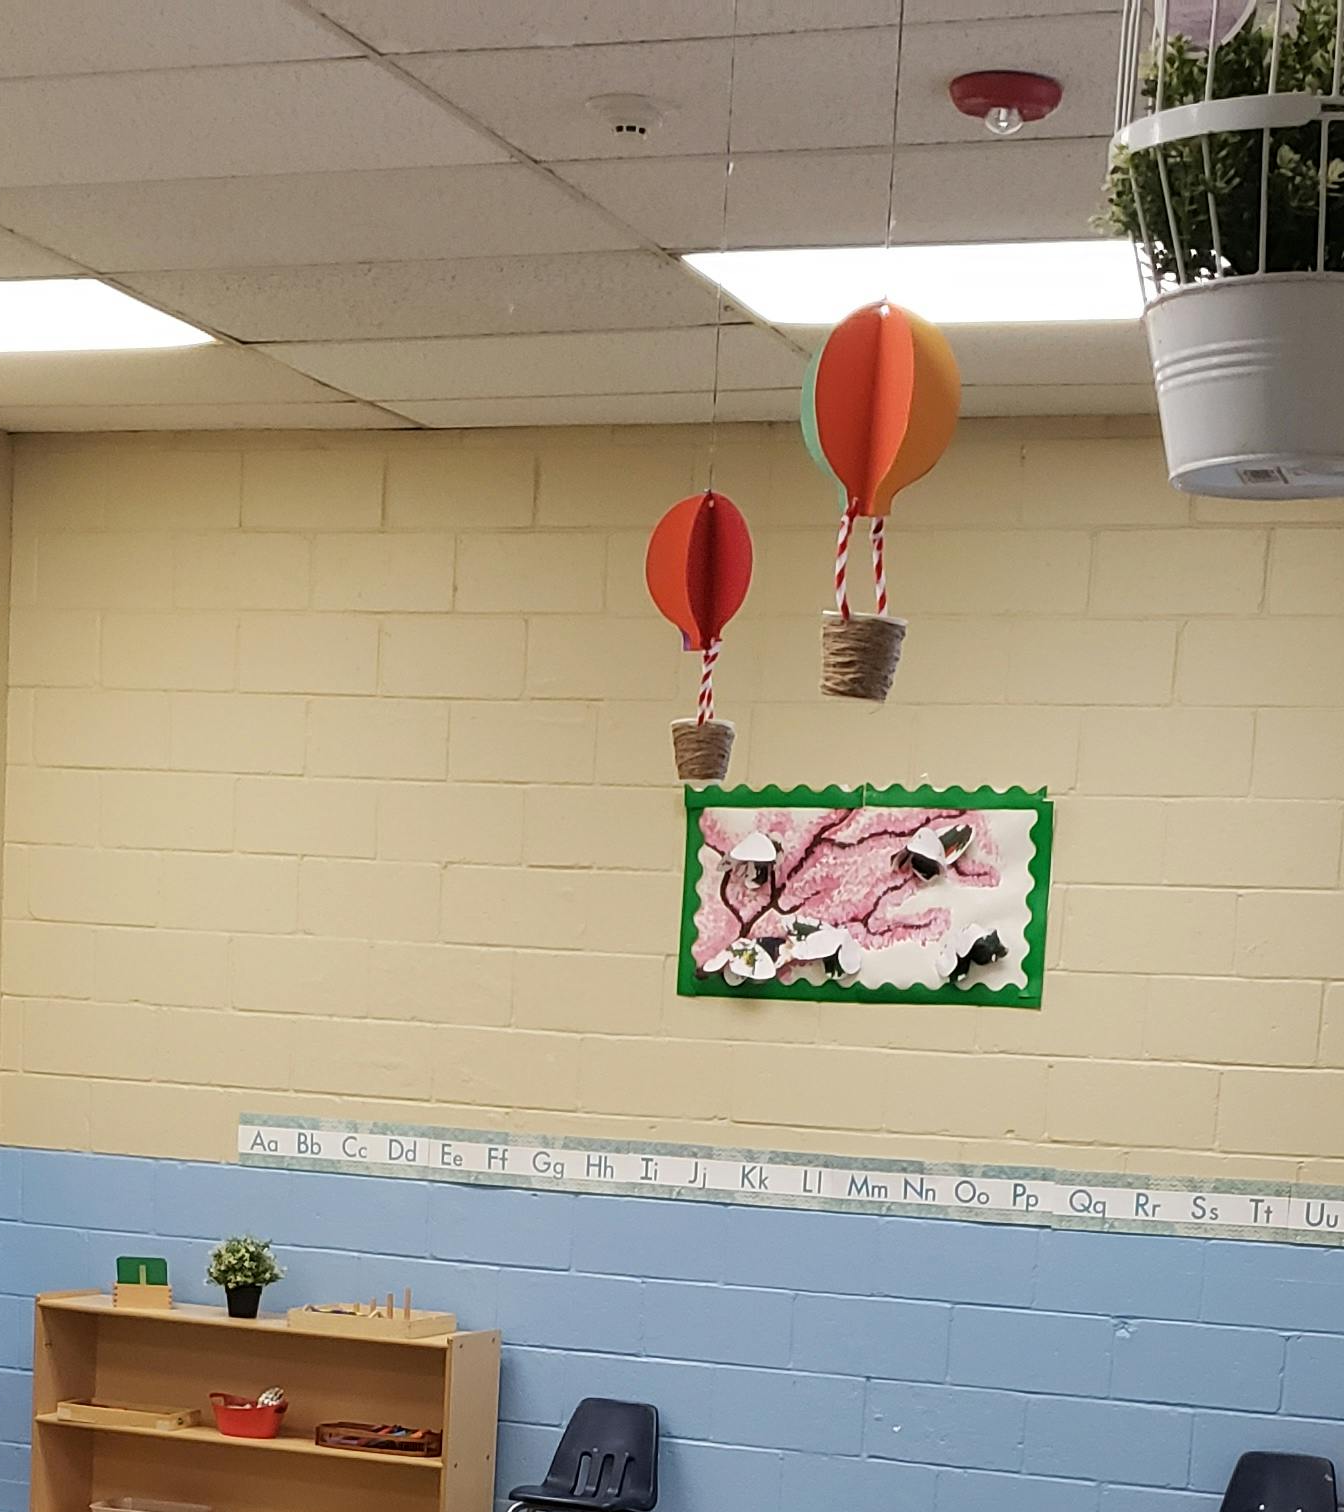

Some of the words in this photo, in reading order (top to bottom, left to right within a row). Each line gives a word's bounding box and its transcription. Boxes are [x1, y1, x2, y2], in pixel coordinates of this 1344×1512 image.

[250, 1131, 278, 1153] Aa
[297, 1133, 322, 1156] Bb
[342, 1136, 368, 1159] Cc
[388, 1139, 417, 1163] Dd
[441, 1144, 463, 1167] Ee
[487, 1148, 509, 1171] Ff
[532, 1151, 565, 1179] Gg
[585, 1155, 614, 1180] Hh
[640, 1157, 658, 1182] Ii
[688, 1161, 708, 1189] Jj
[741, 1164, 769, 1190] Kk
[802, 1170, 823, 1194] Ll
[847, 1175, 888, 1199] Mm
[903, 1177, 936, 1202] Nn
[954, 1180, 990, 1205] Oo
[1012, 1183, 1039, 1211] Pp
[1069, 1189, 1107, 1218] Qq
[1134, 1192, 1161, 1218] Rr
[1191, 1196, 1219, 1221] Ss
[1249, 1198, 1273, 1224] Tt
[1305, 1202, 1339, 1229] Uu
